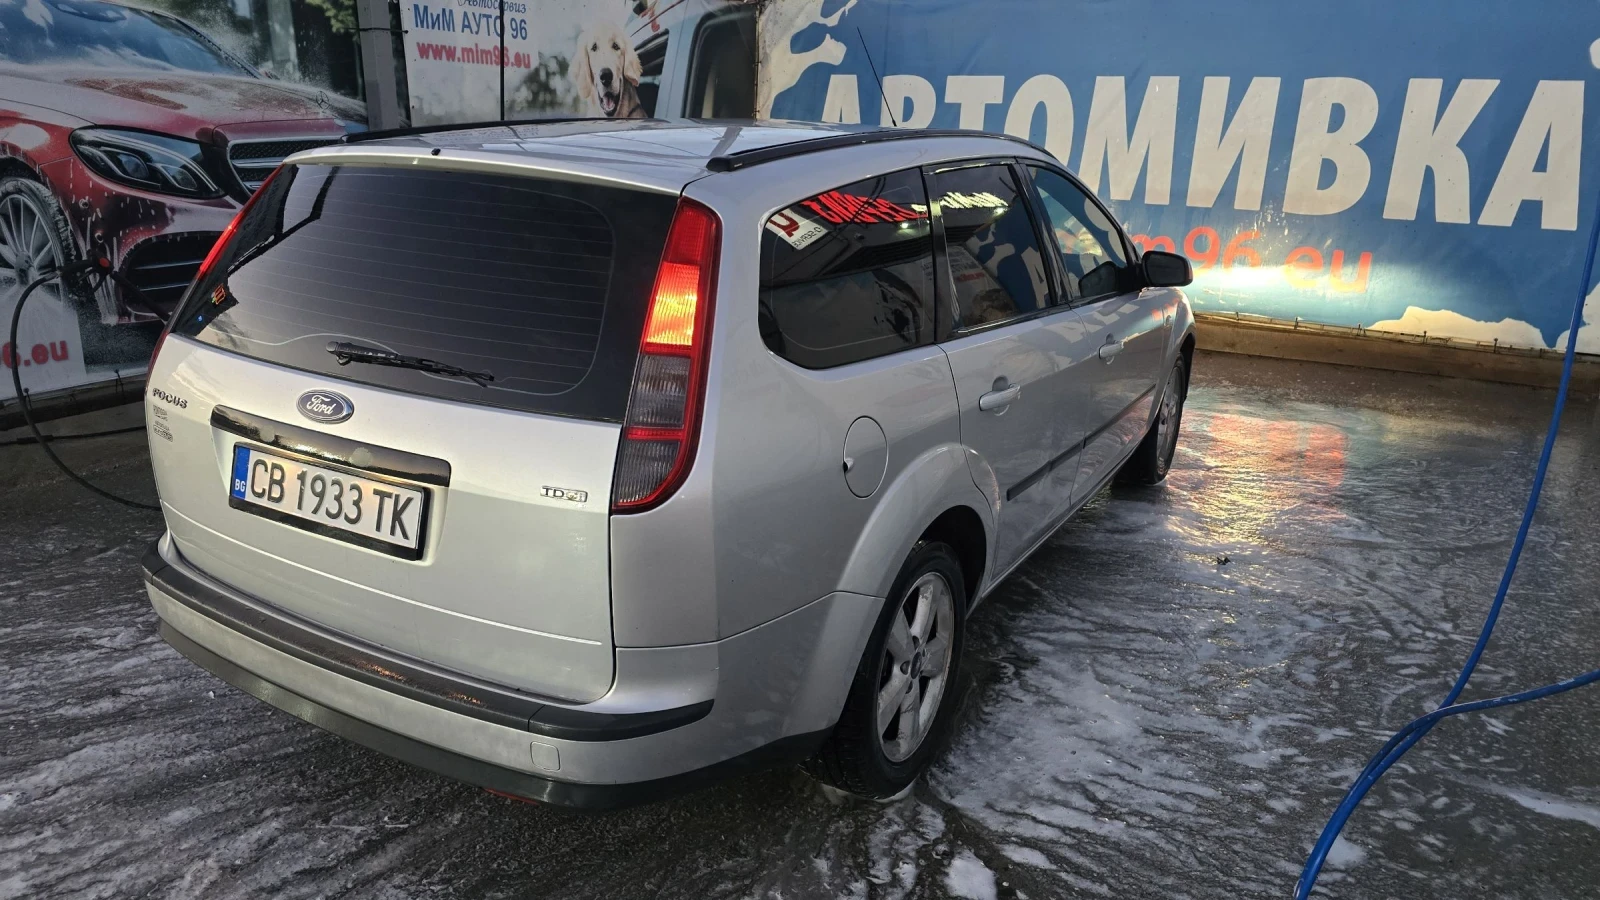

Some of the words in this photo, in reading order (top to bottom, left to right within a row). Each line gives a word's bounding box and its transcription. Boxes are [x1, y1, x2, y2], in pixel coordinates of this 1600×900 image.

[458, 0, 527, 14] втосрвиз
[413, 3, 456, 33] МиМ
[510, 17, 528, 41] 96
[152, 387, 188, 409] FOCUS
[306, 394, 337, 415] Ford
[234, 478, 246, 492] BG
[250, 458, 286, 504] CB
[296, 467, 364, 525] 1933
[372, 487, 415, 541] TK
